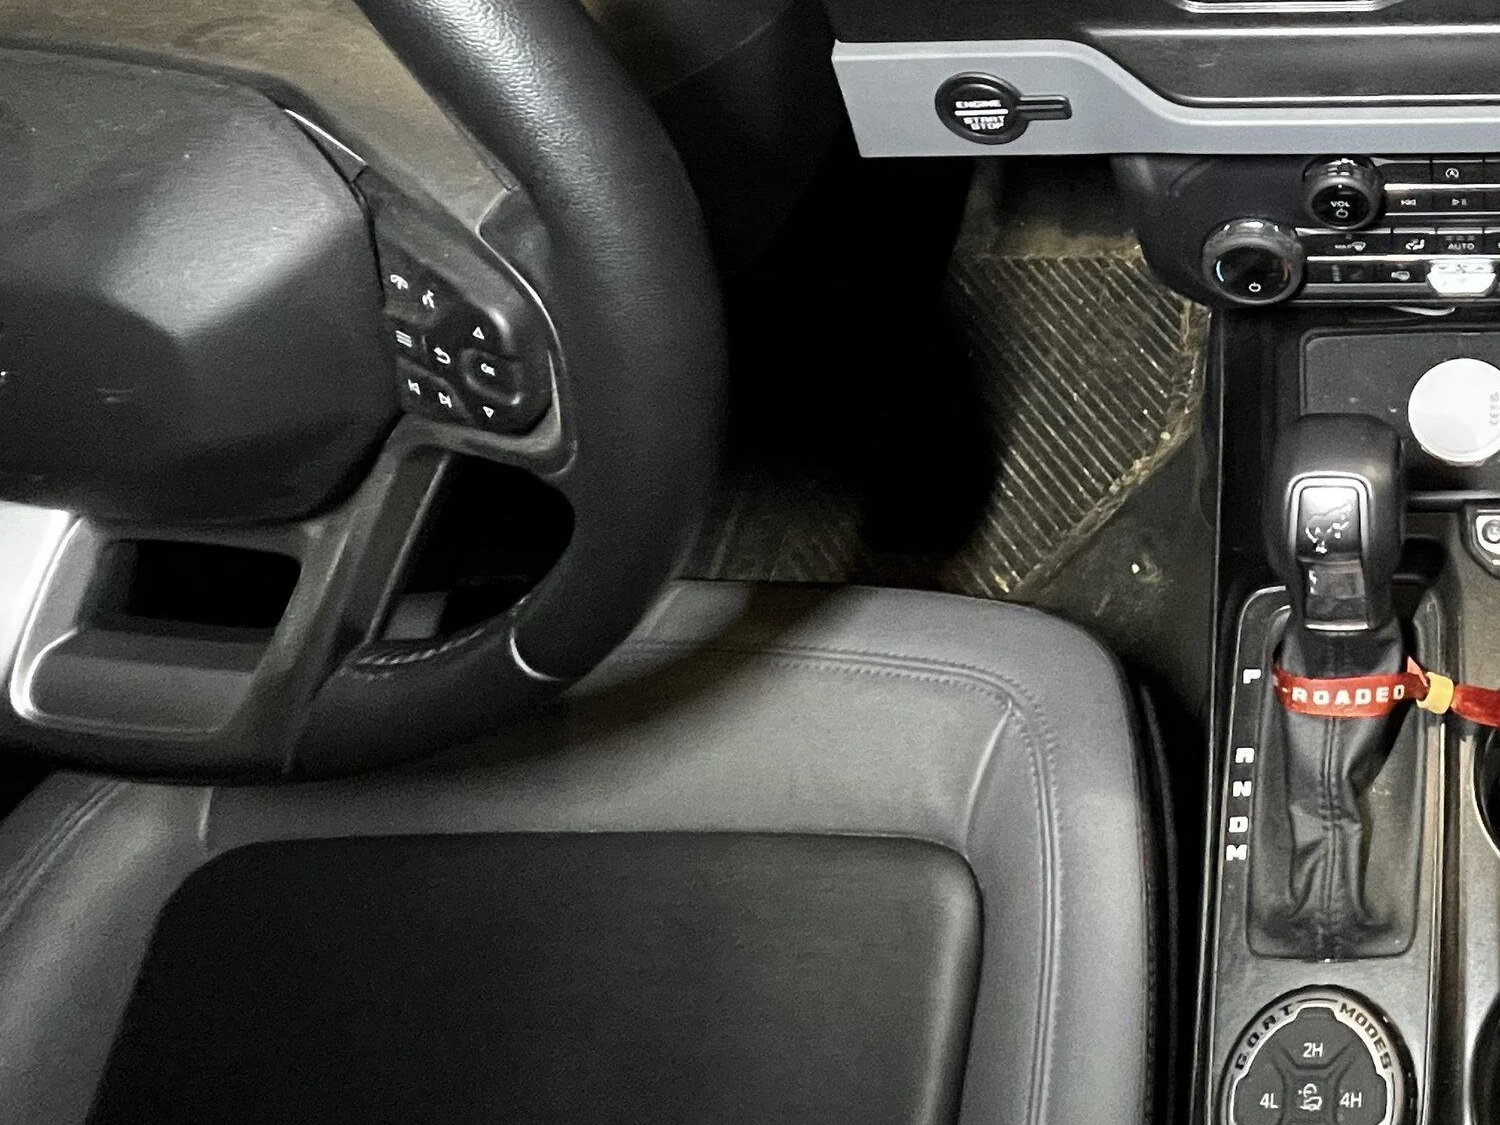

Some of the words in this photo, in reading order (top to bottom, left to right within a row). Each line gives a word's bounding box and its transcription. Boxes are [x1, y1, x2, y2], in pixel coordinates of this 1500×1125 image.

[955, 99, 1002, 109] ENGINE
[963, 115, 1005, 125] START
[970, 123, 1005, 131] STOP
[1330, 200, 1351, 208] VOL
[1447, 242, 1475, 251] AUTO
[1242, 668, 1262, 685] P
[1234, 747, 1255, 764] R
[1232, 780, 1252, 797] N
[1228, 816, 1249, 833] D
[1225, 844, 1248, 861] M
[1339, 1002, 1393, 1070] MODES
[1302, 1042, 1324, 1058] 2H
[1259, 1093, 1280, 1109] 4L
[1339, 1092, 1363, 1109] 4H
